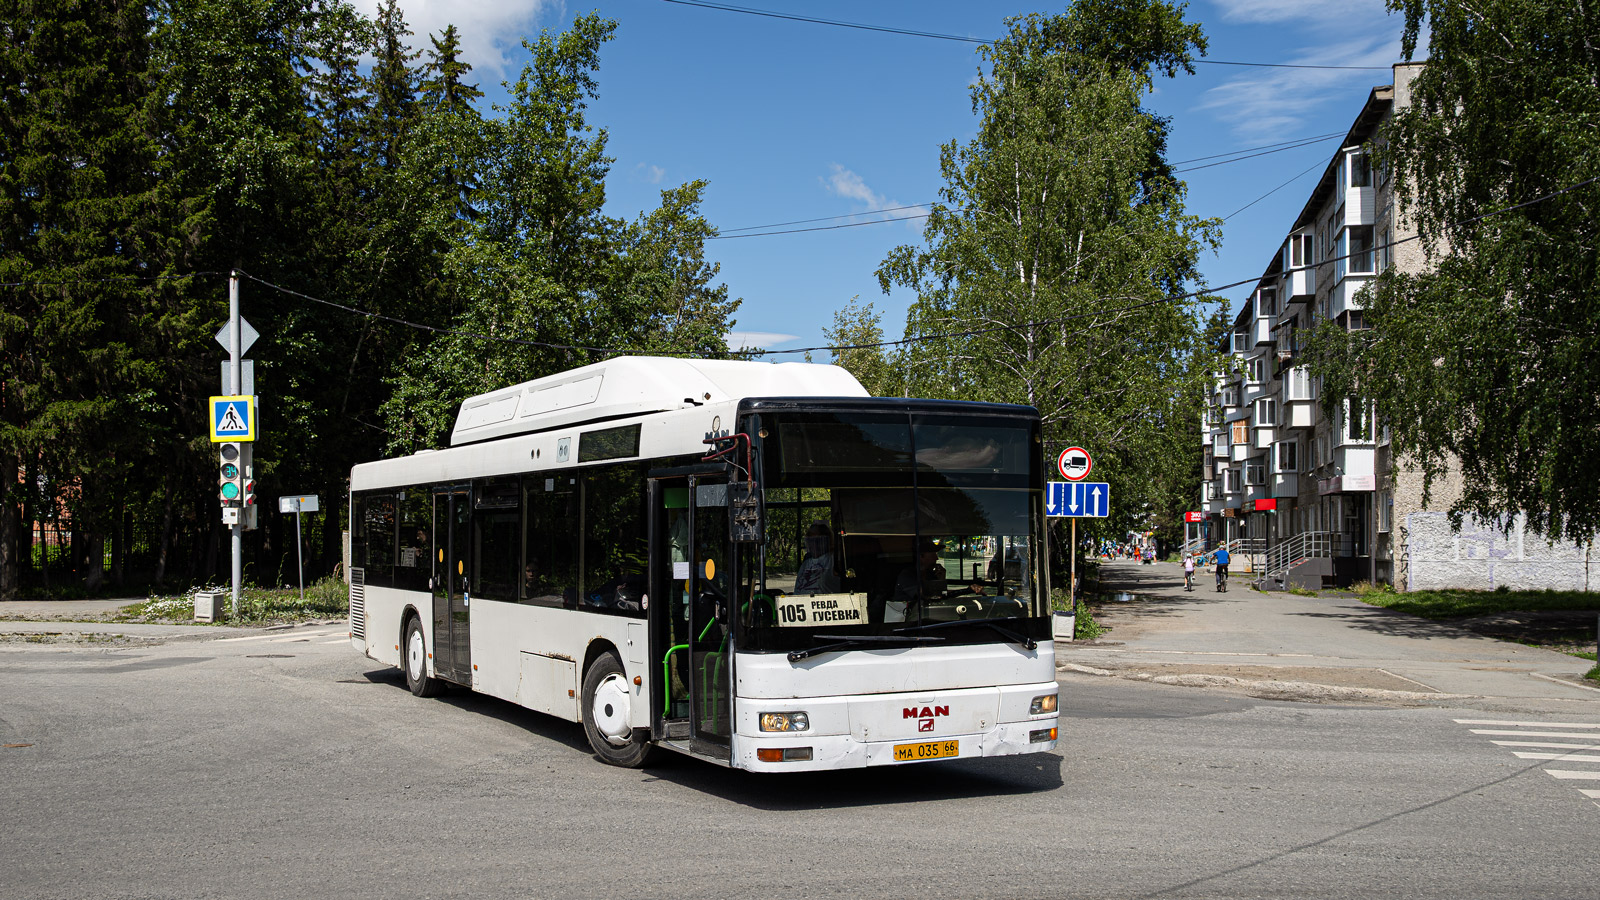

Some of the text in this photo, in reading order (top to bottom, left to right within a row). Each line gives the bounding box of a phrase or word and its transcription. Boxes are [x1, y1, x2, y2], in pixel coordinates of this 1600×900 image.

[226, 466, 237, 478] 34
[811, 600, 839, 610] РЕВДА
[779, 604, 807, 623] 105
[812, 609, 860, 622] ГУСЕВКА
[903, 705, 949, 719] MAN
[918, 744, 939, 757] 035
[944, 742, 955, 751] 66
